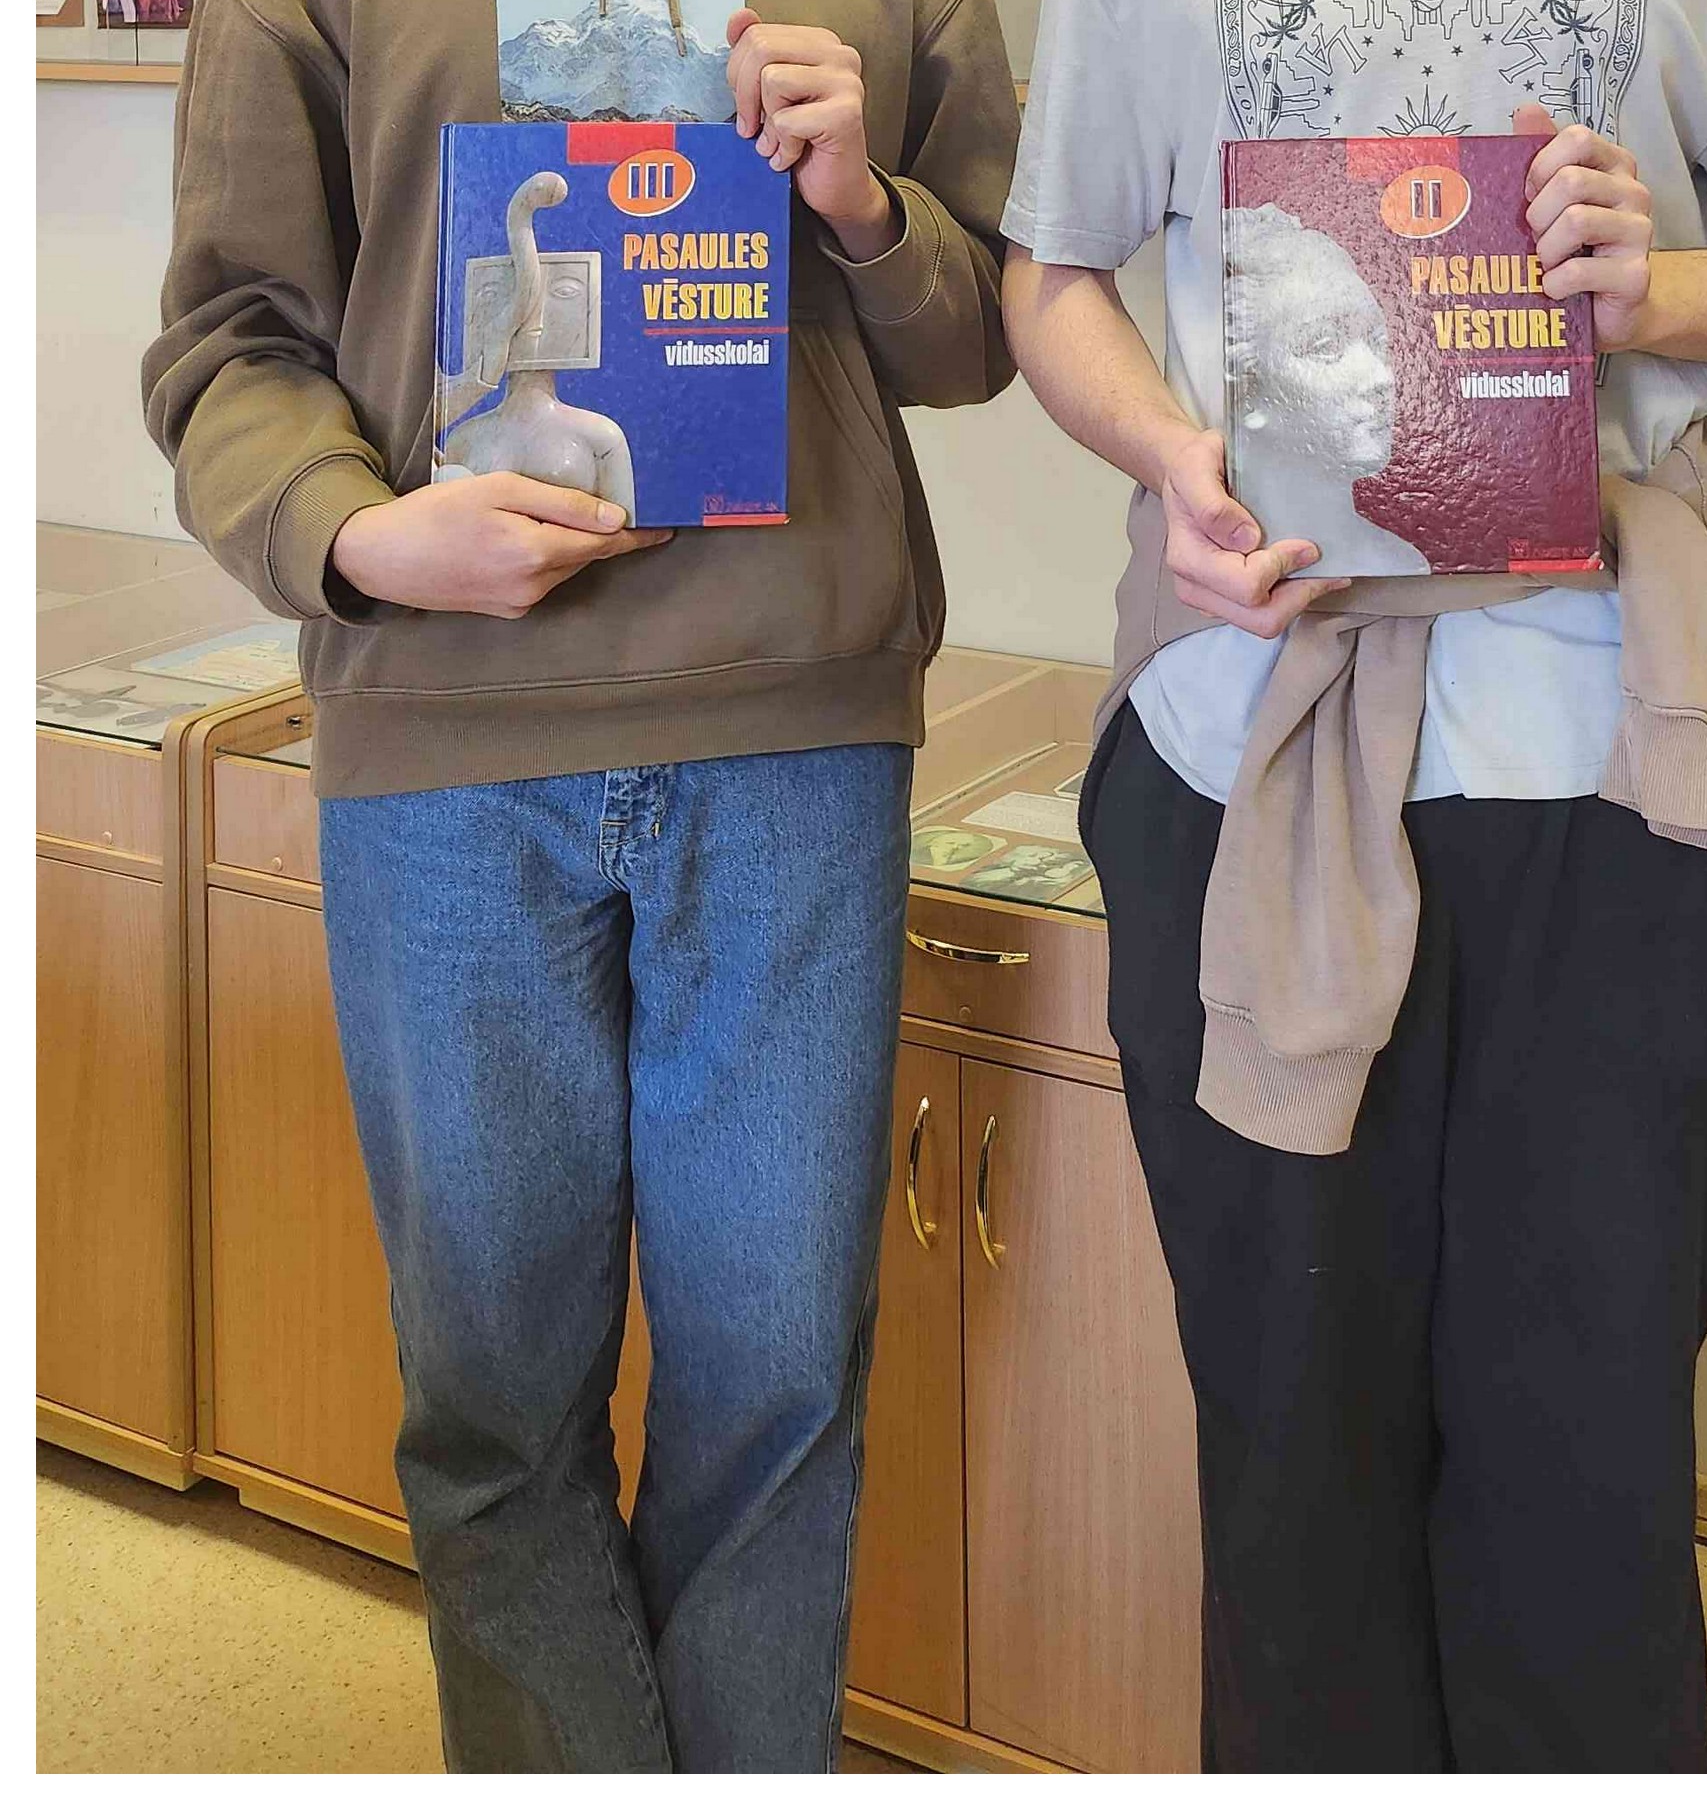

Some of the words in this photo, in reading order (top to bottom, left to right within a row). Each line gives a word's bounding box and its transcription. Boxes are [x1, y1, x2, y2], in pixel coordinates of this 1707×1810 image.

[626, 161, 676, 201] III
[1408, 177, 1443, 221] II
[622, 231, 769, 272] PASAULES
[1410, 255, 1542, 297] PASAULE
[641, 277, 770, 322] VĒSTURE
[1432, 302, 1568, 351] VĒSTURE
[664, 339, 771, 368] vidusskolai
[1460, 369, 1571, 400] vidusskolai
